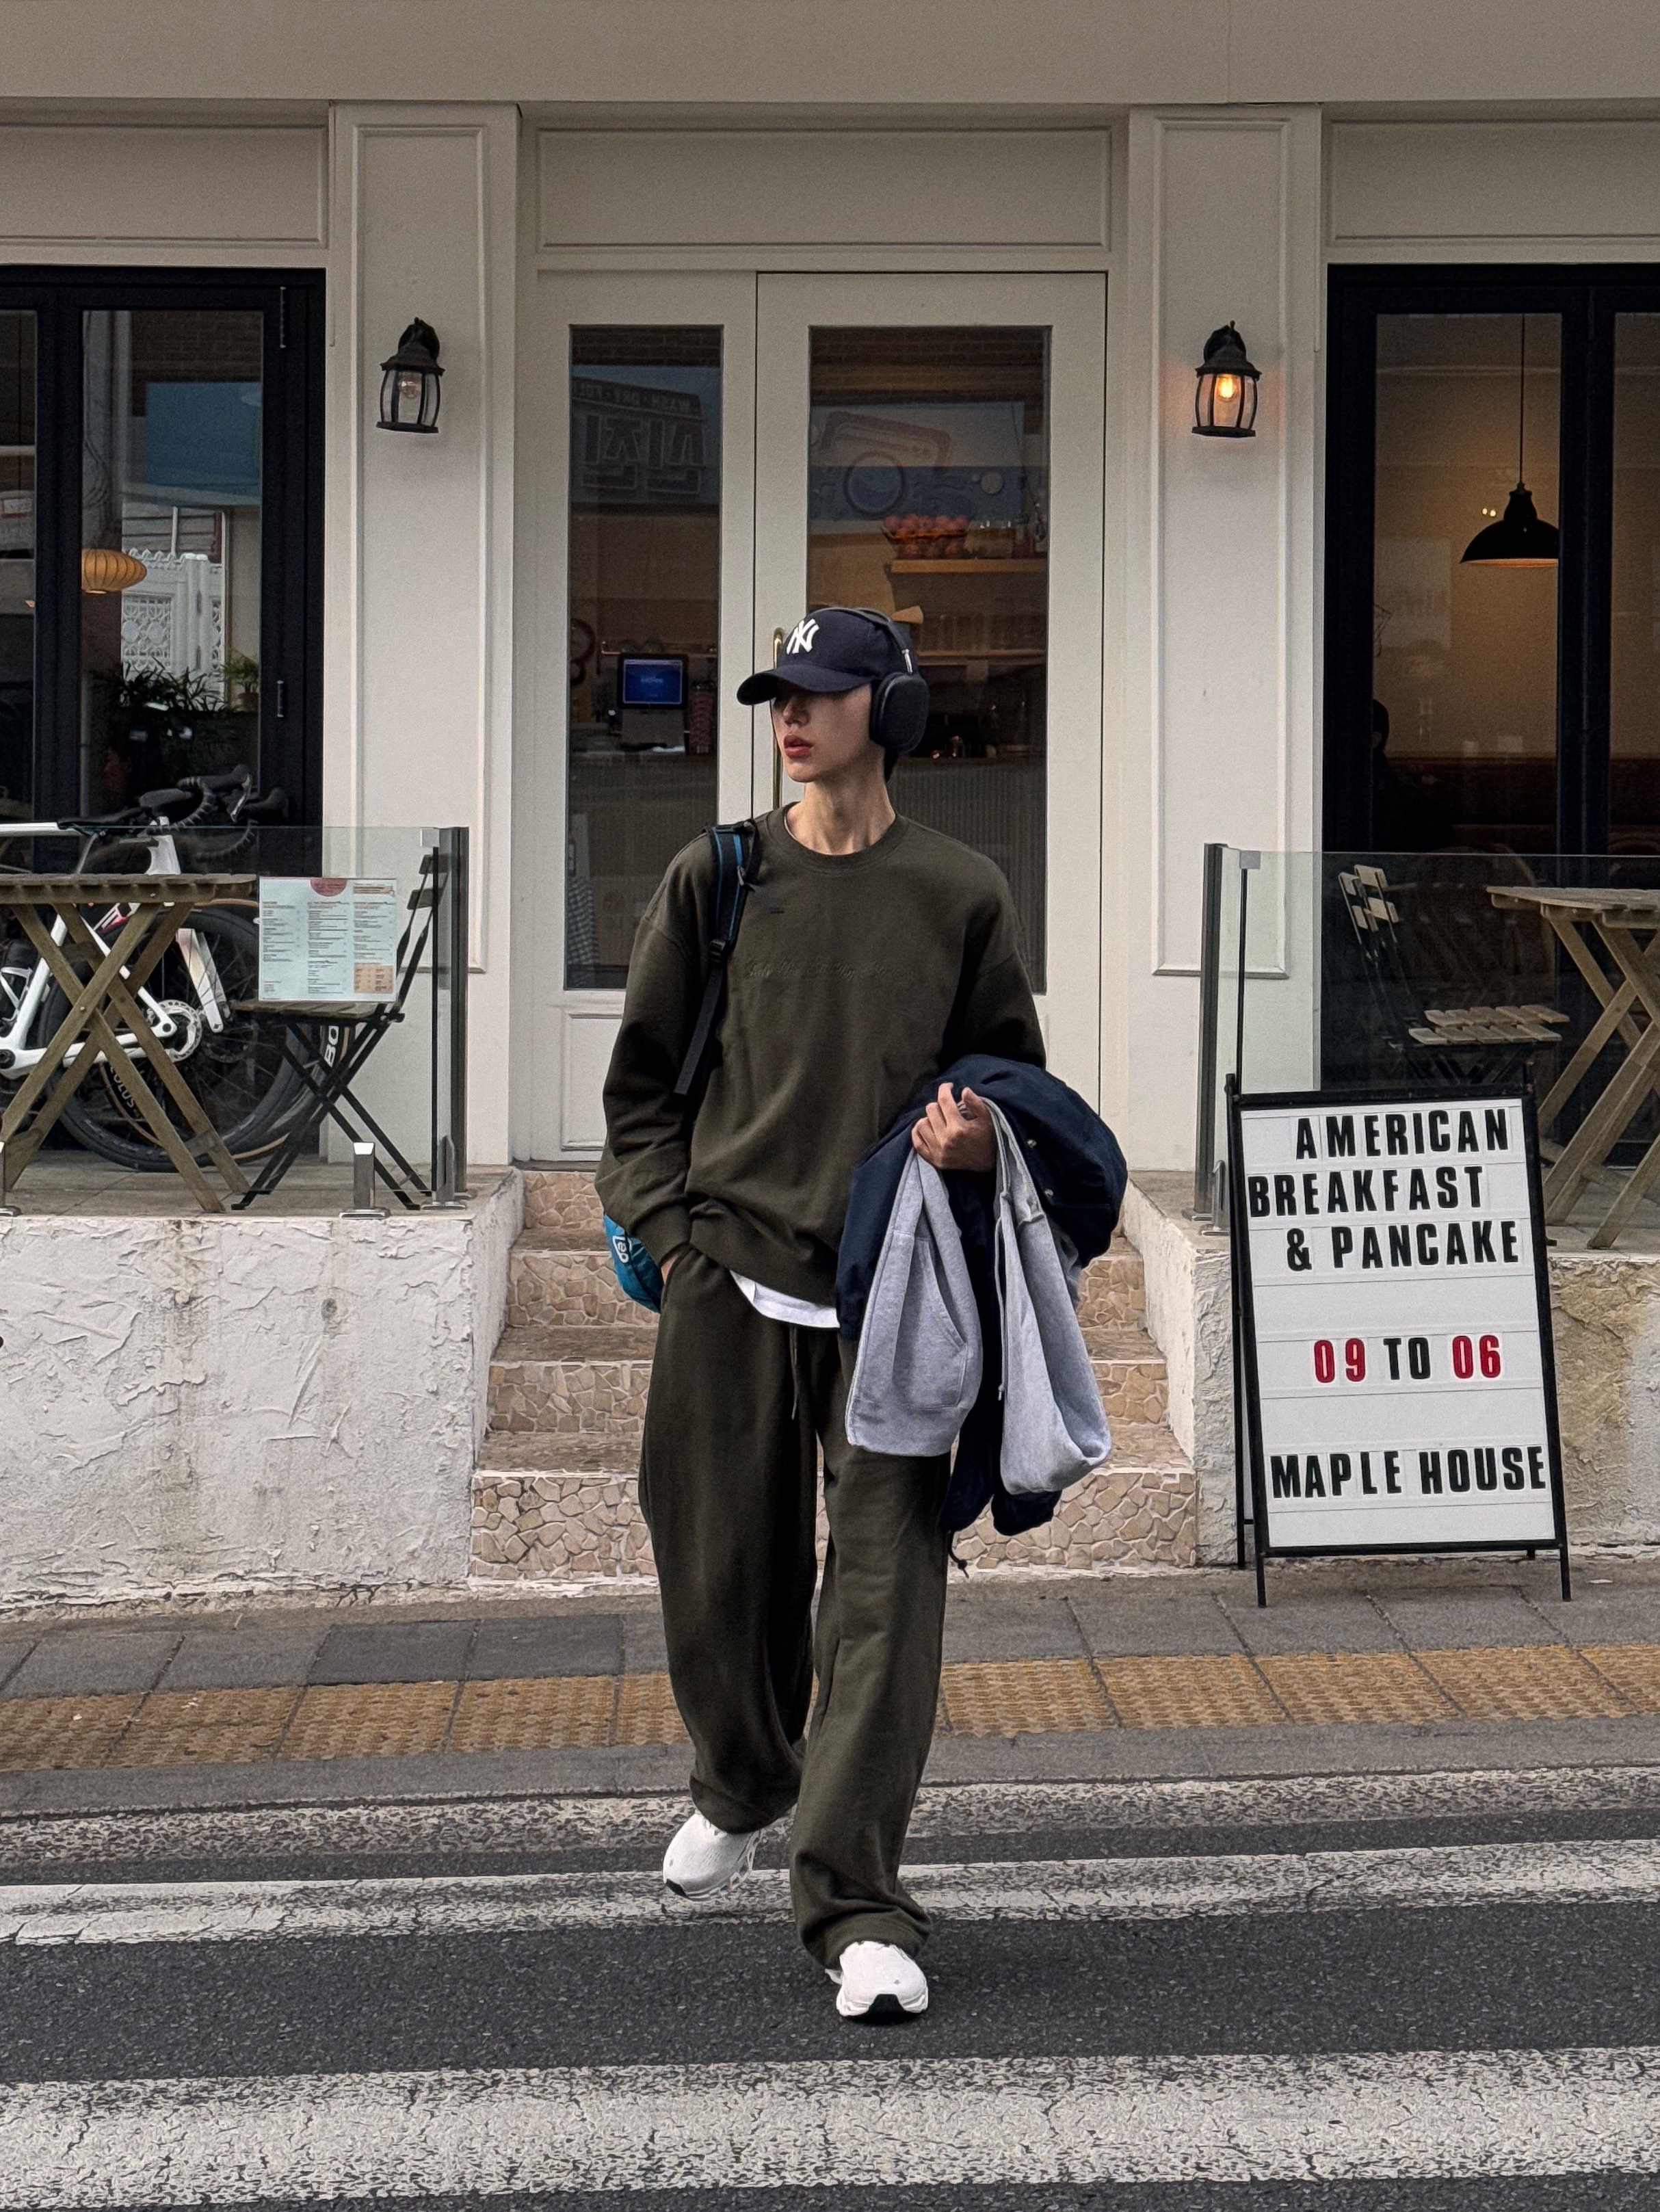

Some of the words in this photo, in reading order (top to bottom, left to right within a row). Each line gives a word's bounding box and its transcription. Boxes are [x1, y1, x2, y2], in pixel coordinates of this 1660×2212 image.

[786, 618, 819, 655] NY
[1296, 1109, 1508, 1160] AMERICAN
[1248, 1166, 1483, 1217] BREAKFAST
[1287, 1228, 1313, 1272] &
[1332, 1221, 1518, 1269] PANCAKE
[1314, 1339, 1366, 1383] 09
[1383, 1338, 1431, 1380] TO
[1452, 1335, 1501, 1379] 06
[1271, 1451, 1402, 1499] MAPLE
[1419, 1447, 1546, 1495] HOUSE
